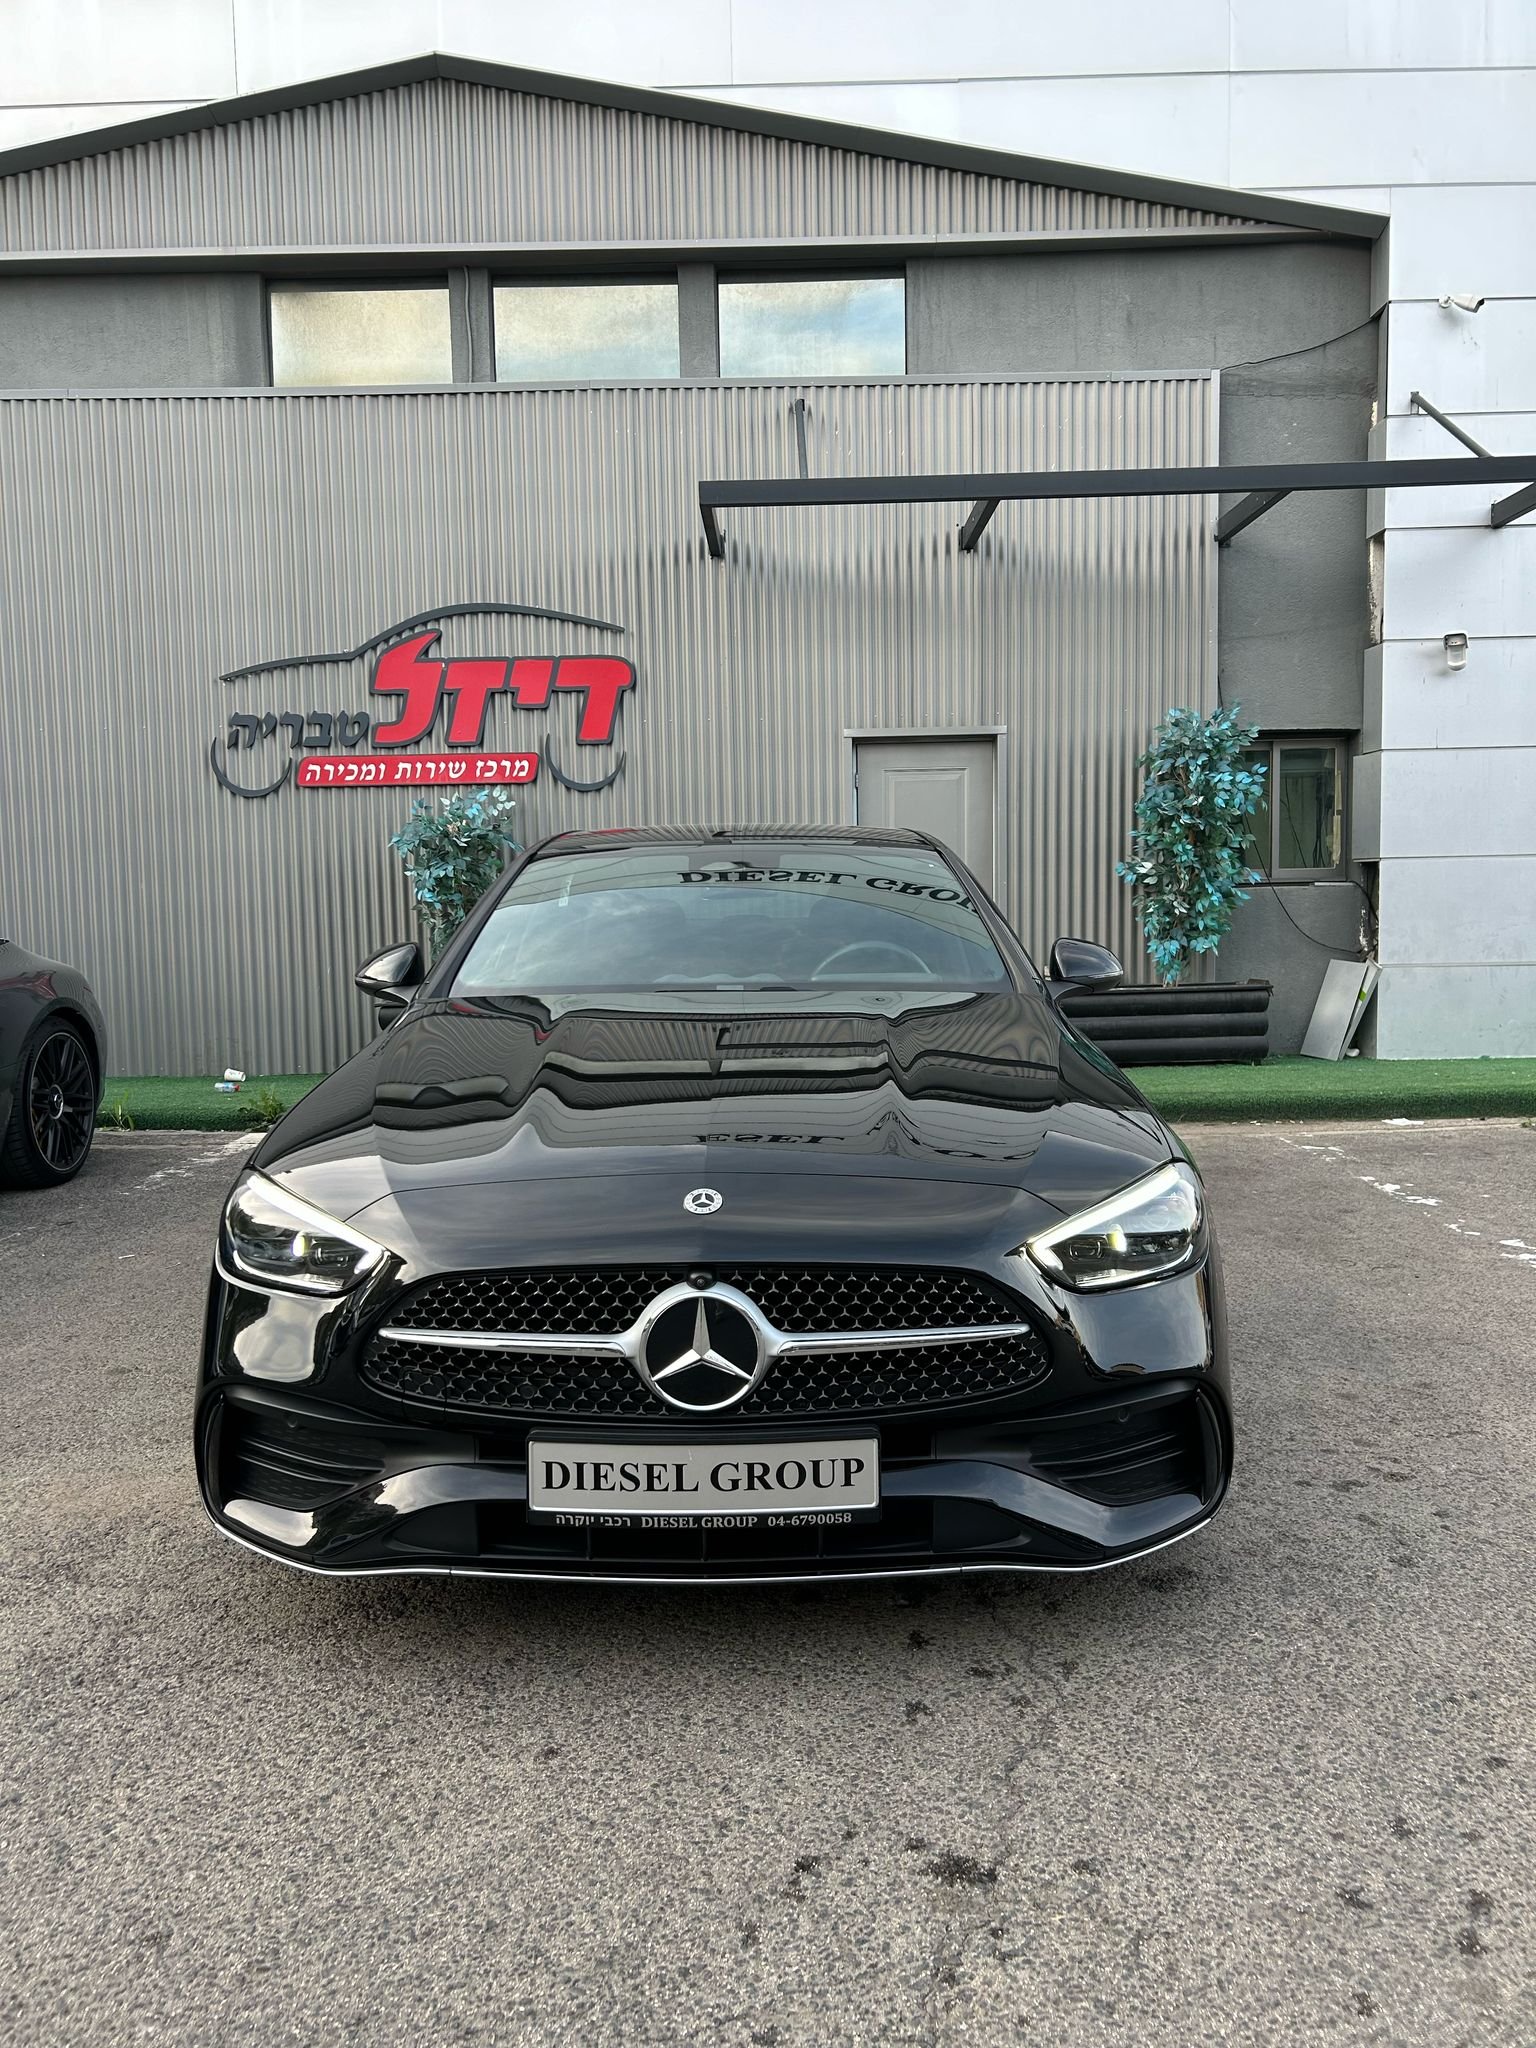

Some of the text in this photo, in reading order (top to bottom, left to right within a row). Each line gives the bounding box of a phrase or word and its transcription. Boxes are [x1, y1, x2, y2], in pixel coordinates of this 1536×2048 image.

[227, 629, 636, 750] דיזל טבריה
[305, 757, 530, 782] מרכז שירות ומכירה
[541, 1457, 865, 1493] DIESEL GROUP
[599, 1516, 631, 1527] רכבי
[641, 1516, 698, 1528] DIESEL
[701, 1516, 758, 1528] GROUP
[767, 1512, 852, 1527] 04-6790058
